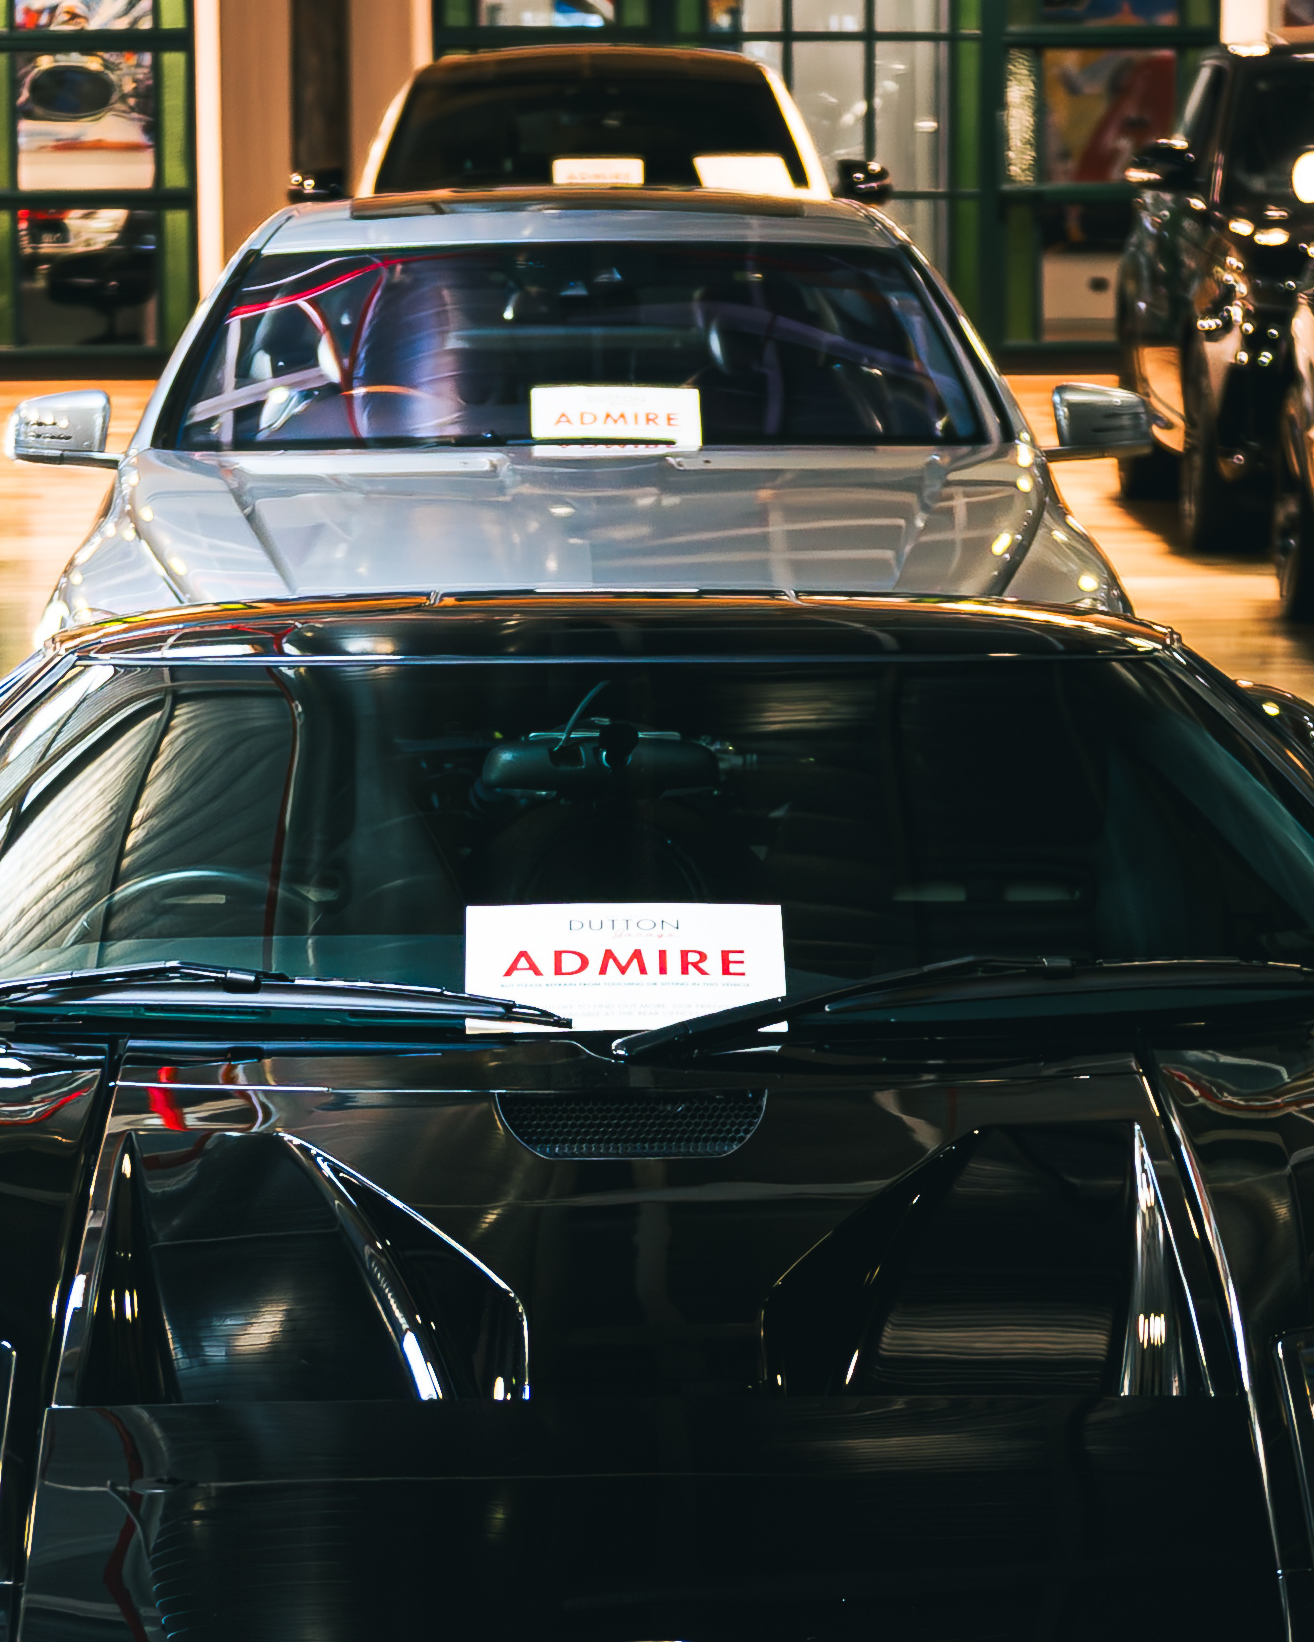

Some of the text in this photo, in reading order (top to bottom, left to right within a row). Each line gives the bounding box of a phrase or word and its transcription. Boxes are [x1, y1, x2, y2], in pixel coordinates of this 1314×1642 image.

[553, 410, 680, 427] ADMIRE
[568, 917, 681, 932] DUTTON
[501, 948, 747, 978] ADMIRE
